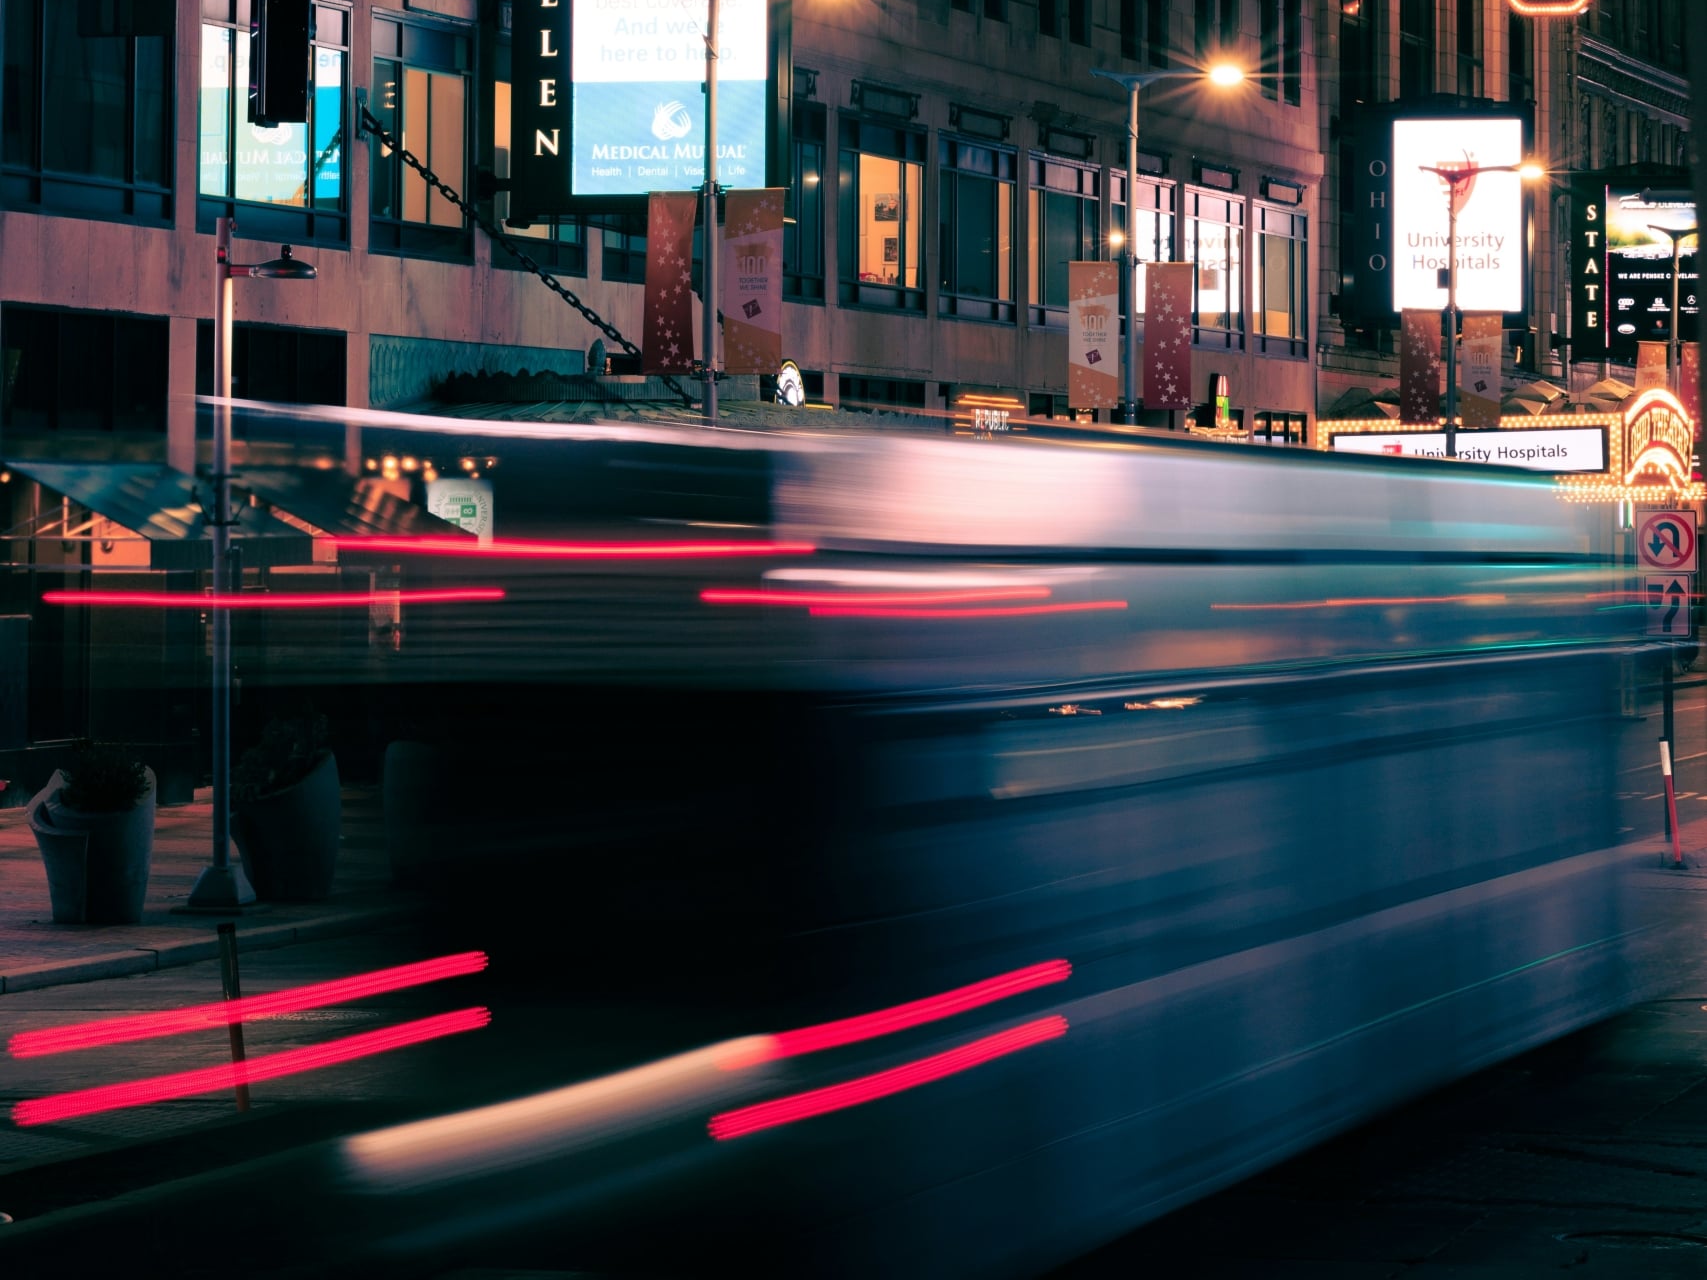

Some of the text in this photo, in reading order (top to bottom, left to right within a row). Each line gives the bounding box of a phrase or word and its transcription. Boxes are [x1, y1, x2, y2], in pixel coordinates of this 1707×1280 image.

[613, 16, 725, 36] And we'e
[600, 41, 737, 65] here to hep.
[591, 143, 746, 160] MEDICAL MUUAL
[591, 166, 622, 176] Health
[637, 166, 669, 176] Dental
[728, 166, 746, 176] Life
[1368, 159, 1387, 271] OHIO
[1407, 231, 1504, 252] University
[1584, 204, 1599, 328] STATE
[975, 408, 1010, 431] REPUBLIC
[1414, 444, 1568, 464] Unirsity Hospitals
